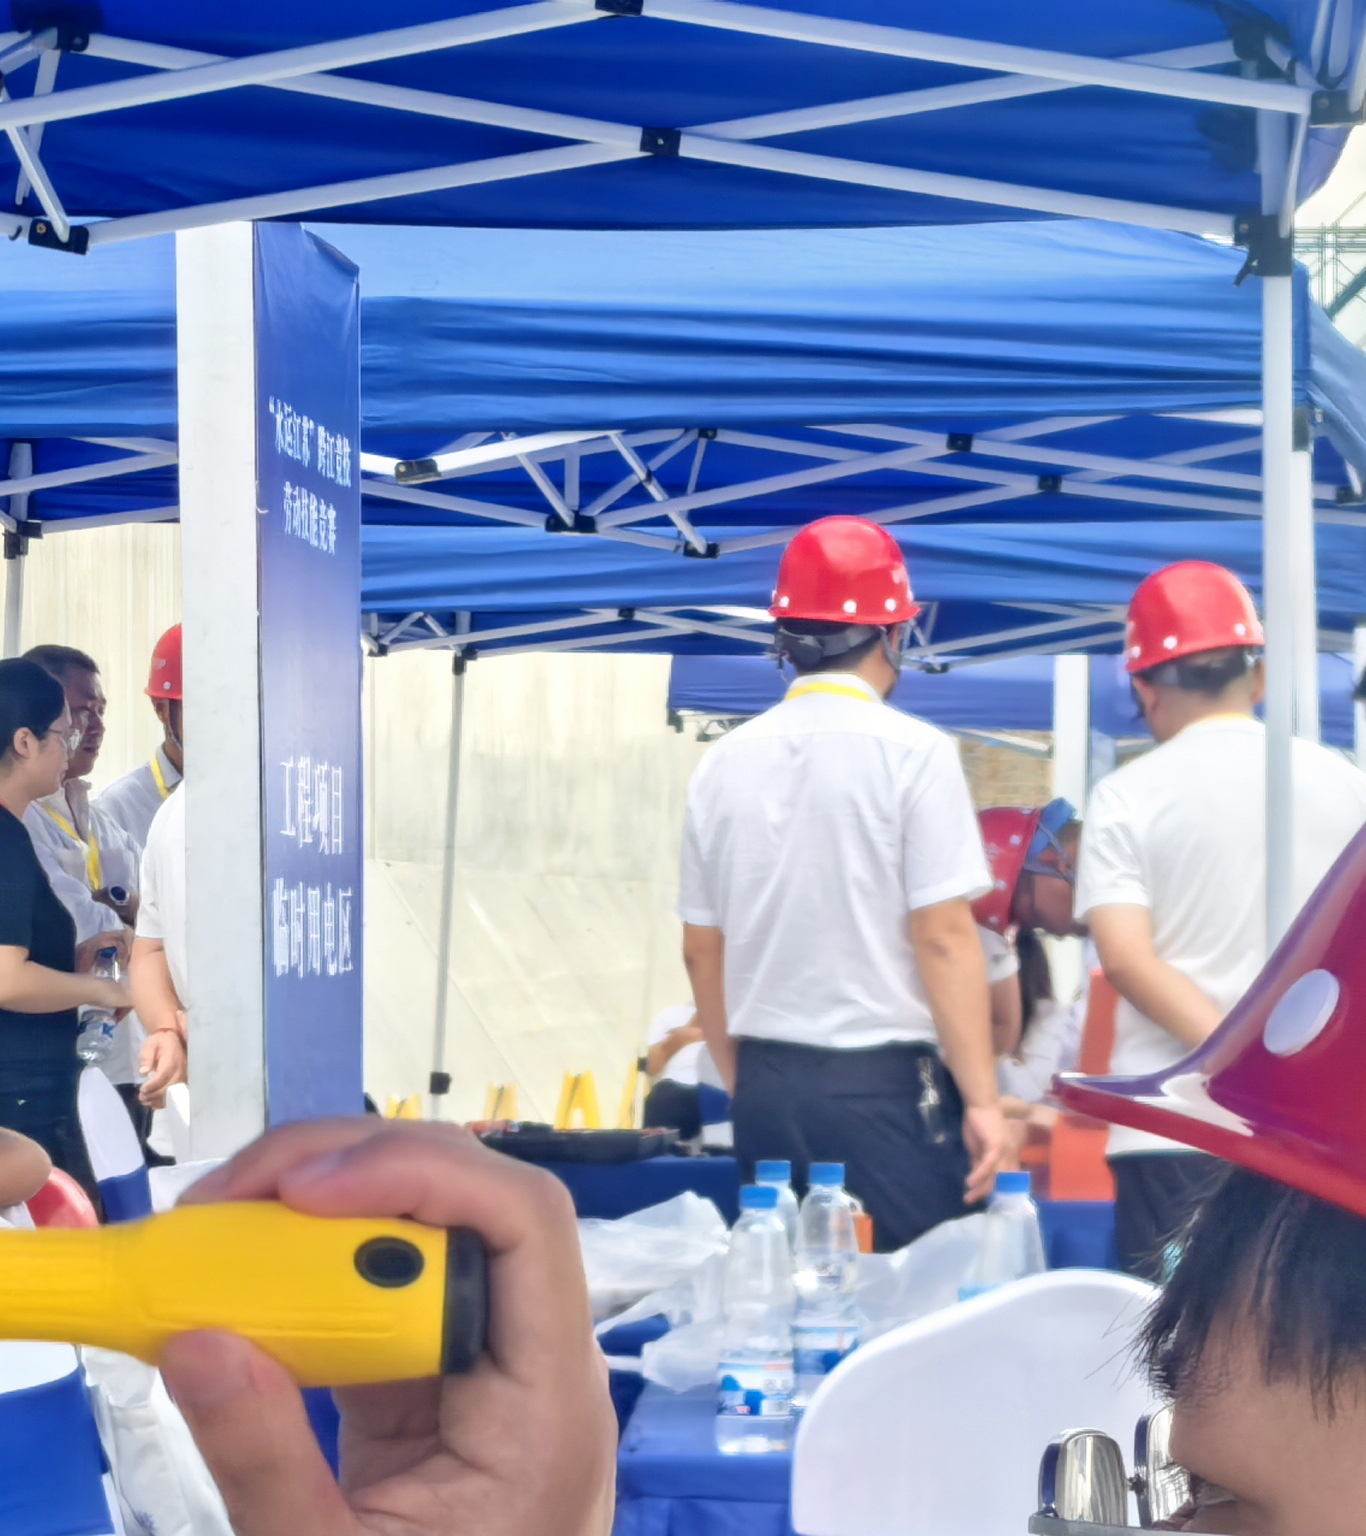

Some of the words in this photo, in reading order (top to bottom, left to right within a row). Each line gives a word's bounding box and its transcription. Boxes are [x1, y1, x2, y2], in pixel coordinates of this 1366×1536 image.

[280, 756, 342, 854] 工程项目
[273, 878, 353, 979] 临时用电区
